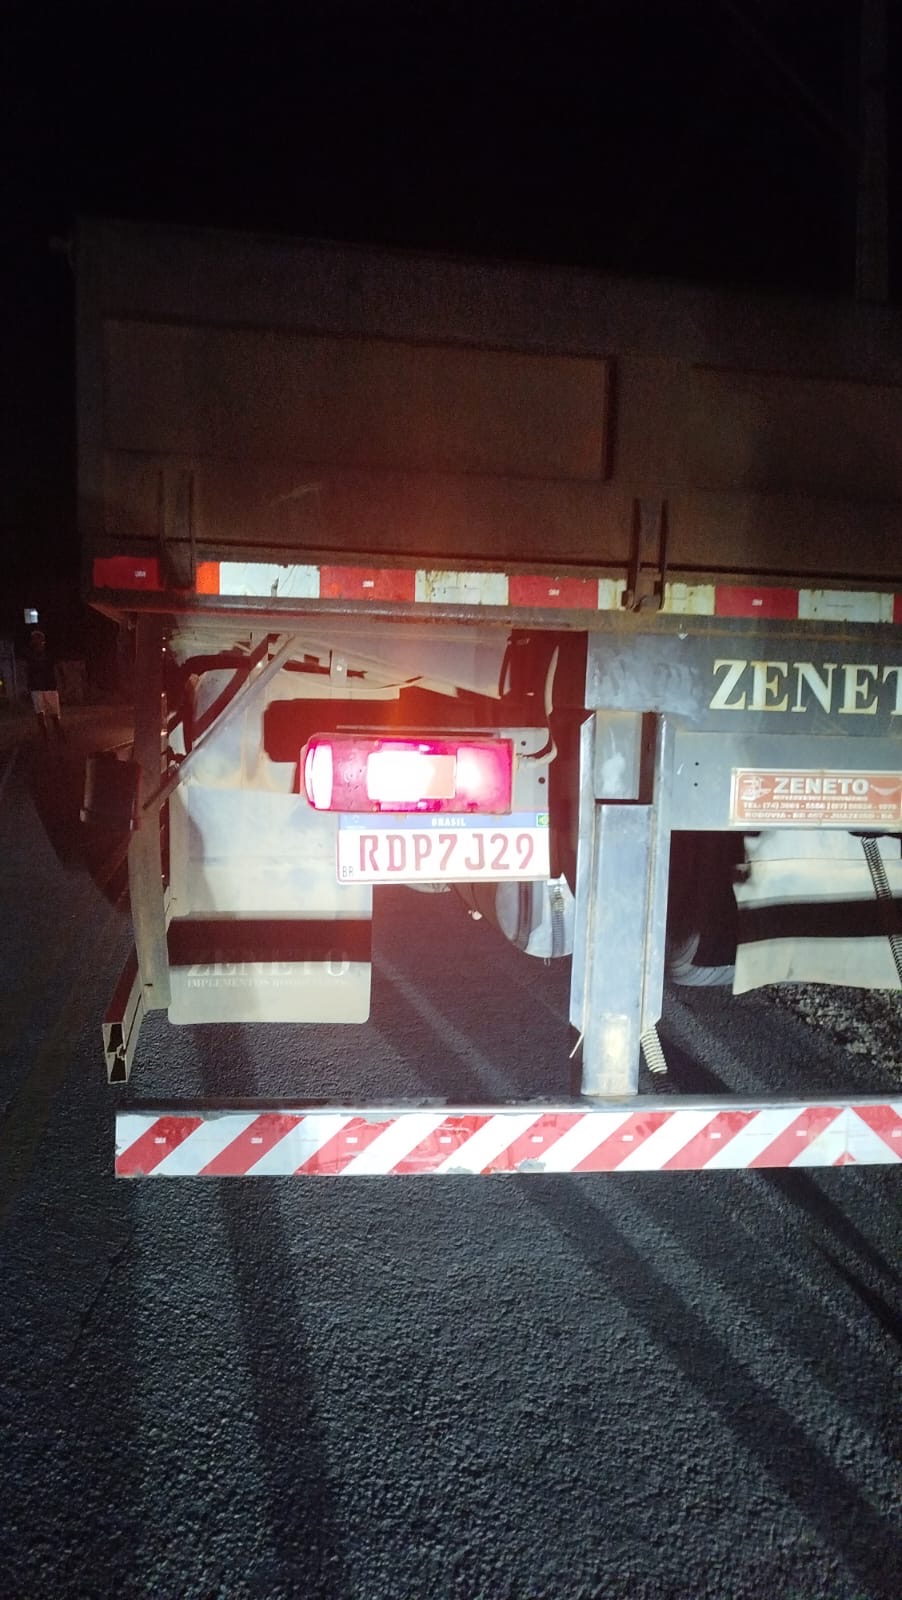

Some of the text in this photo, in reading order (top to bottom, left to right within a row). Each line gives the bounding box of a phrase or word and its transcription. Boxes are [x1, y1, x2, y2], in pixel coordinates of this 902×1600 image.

[772, 777, 870, 796] ZENETO
[431, 817, 467, 827] BRASIL
[359, 833, 534, 872] RDP7J29
[342, 865, 355, 878] BR
